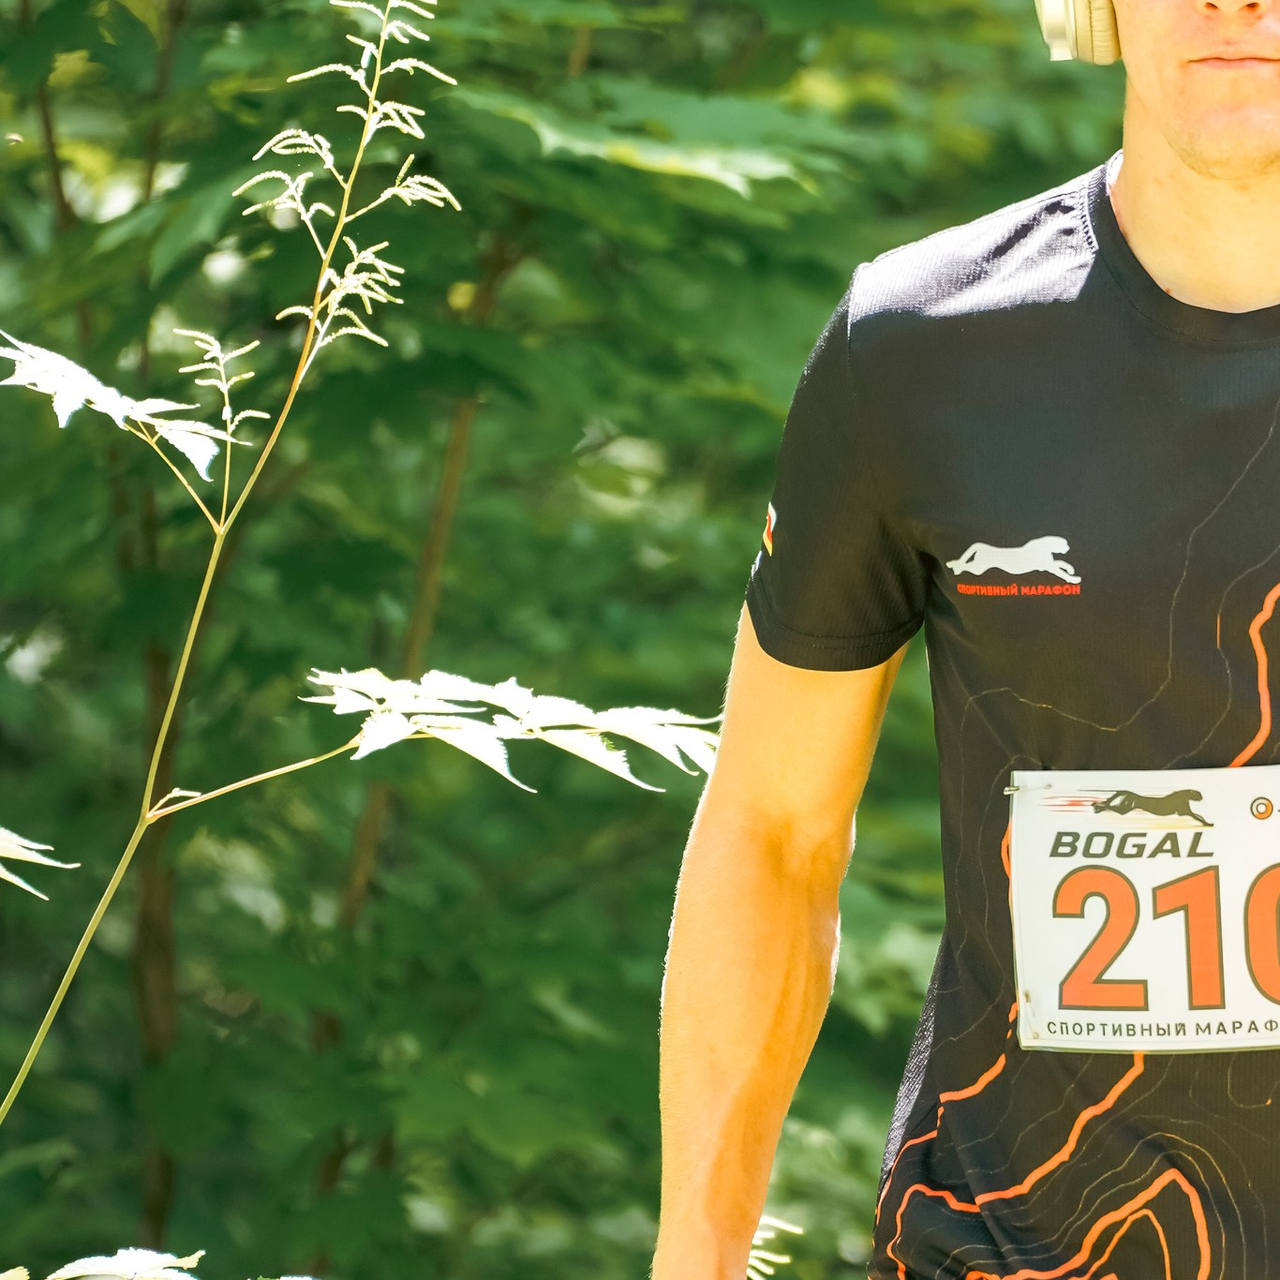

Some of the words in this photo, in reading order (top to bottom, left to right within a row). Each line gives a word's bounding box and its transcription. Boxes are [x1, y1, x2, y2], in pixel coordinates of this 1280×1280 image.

[1020, 584, 1080, 596] МАРАФОН
[1049, 831, 1215, 859] BOGAL
[1047, 1021, 1187, 1037] СПОРТИВНЫЙ
